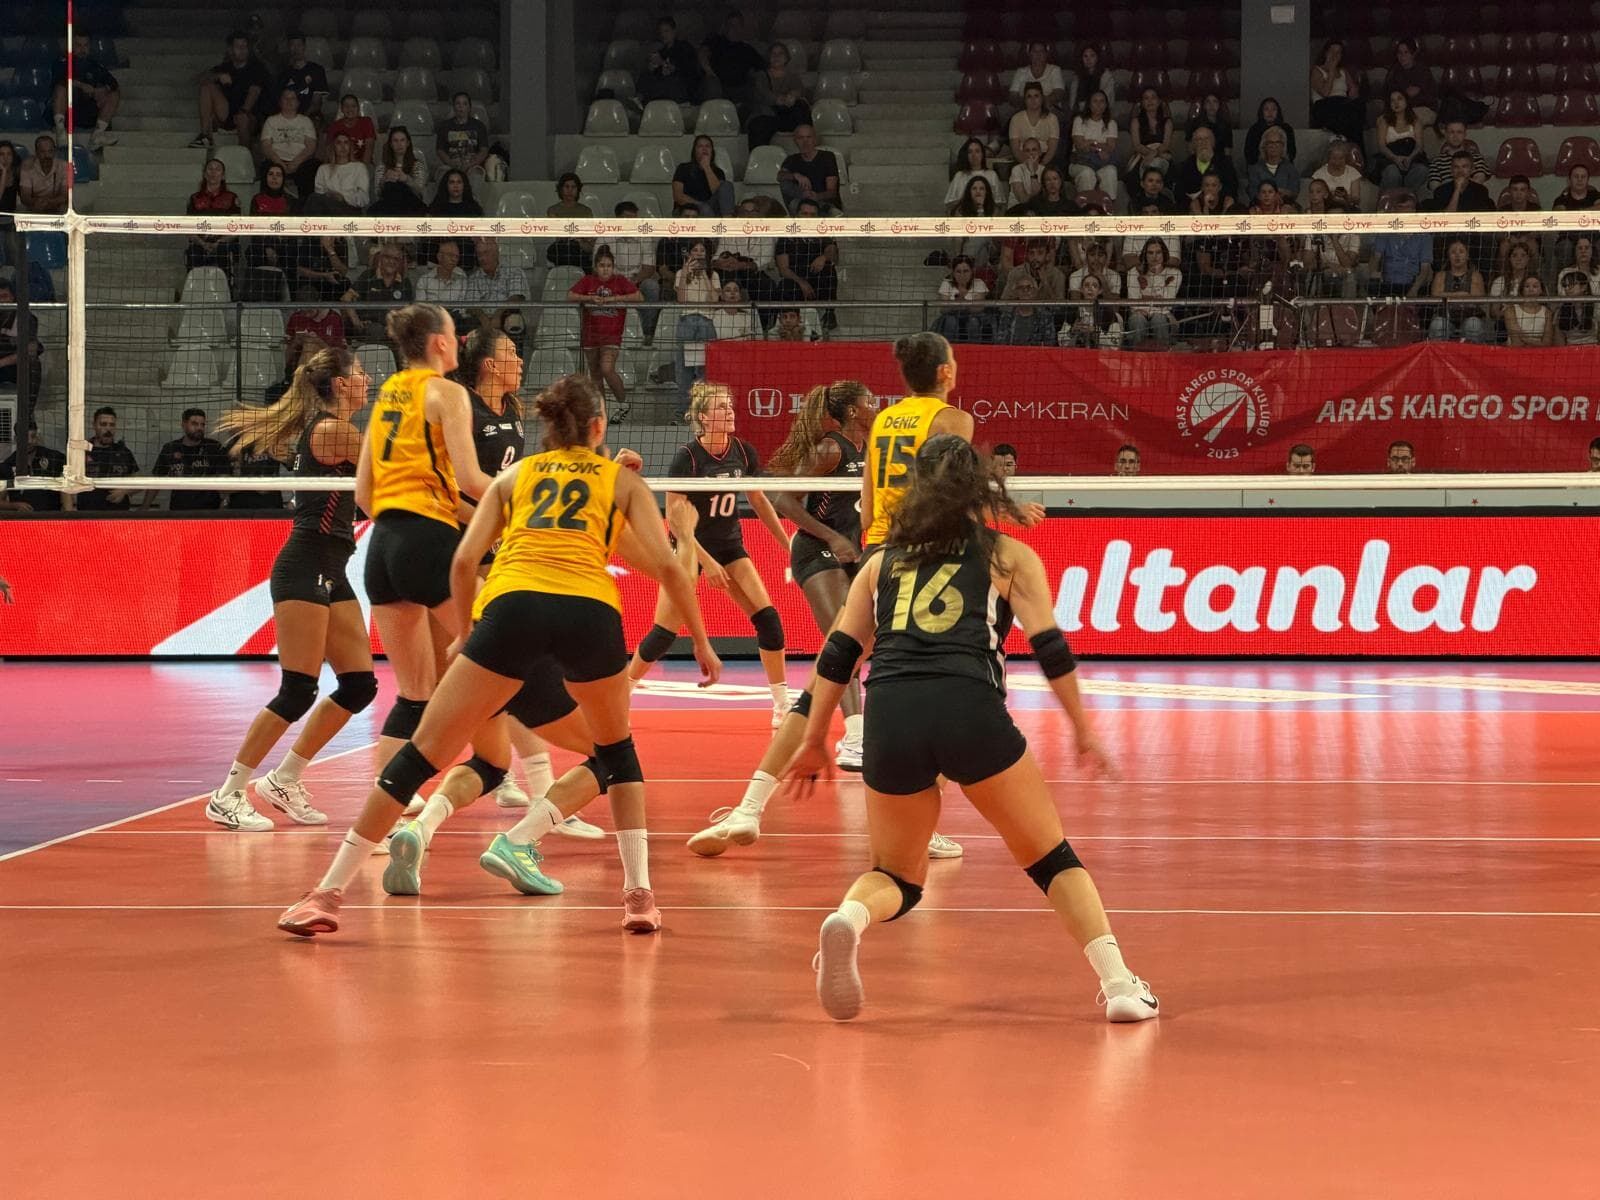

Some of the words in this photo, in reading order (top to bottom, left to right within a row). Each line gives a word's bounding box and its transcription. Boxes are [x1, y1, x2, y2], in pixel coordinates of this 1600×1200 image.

[1179, 370, 1216, 403] KARGO
[1220, 368, 1254, 387] SPOR
[972, 400, 1129, 424] ÇAMKIRAN
[1176, 405, 1192, 437] ARAS
[1315, 395, 1395, 424] ARAS
[1400, 394, 1504, 420] KARGO
[1508, 395, 1590, 421] SPOR
[381, 410, 403, 462] 7
[875, 435, 917, 489] 15
[1207, 447, 1239, 460] 2023
[526, 477, 590, 532] 22
[710, 492, 736, 517] 10
[889, 560, 964, 634] 16
[1013, 538, 1538, 633] ultanlar
